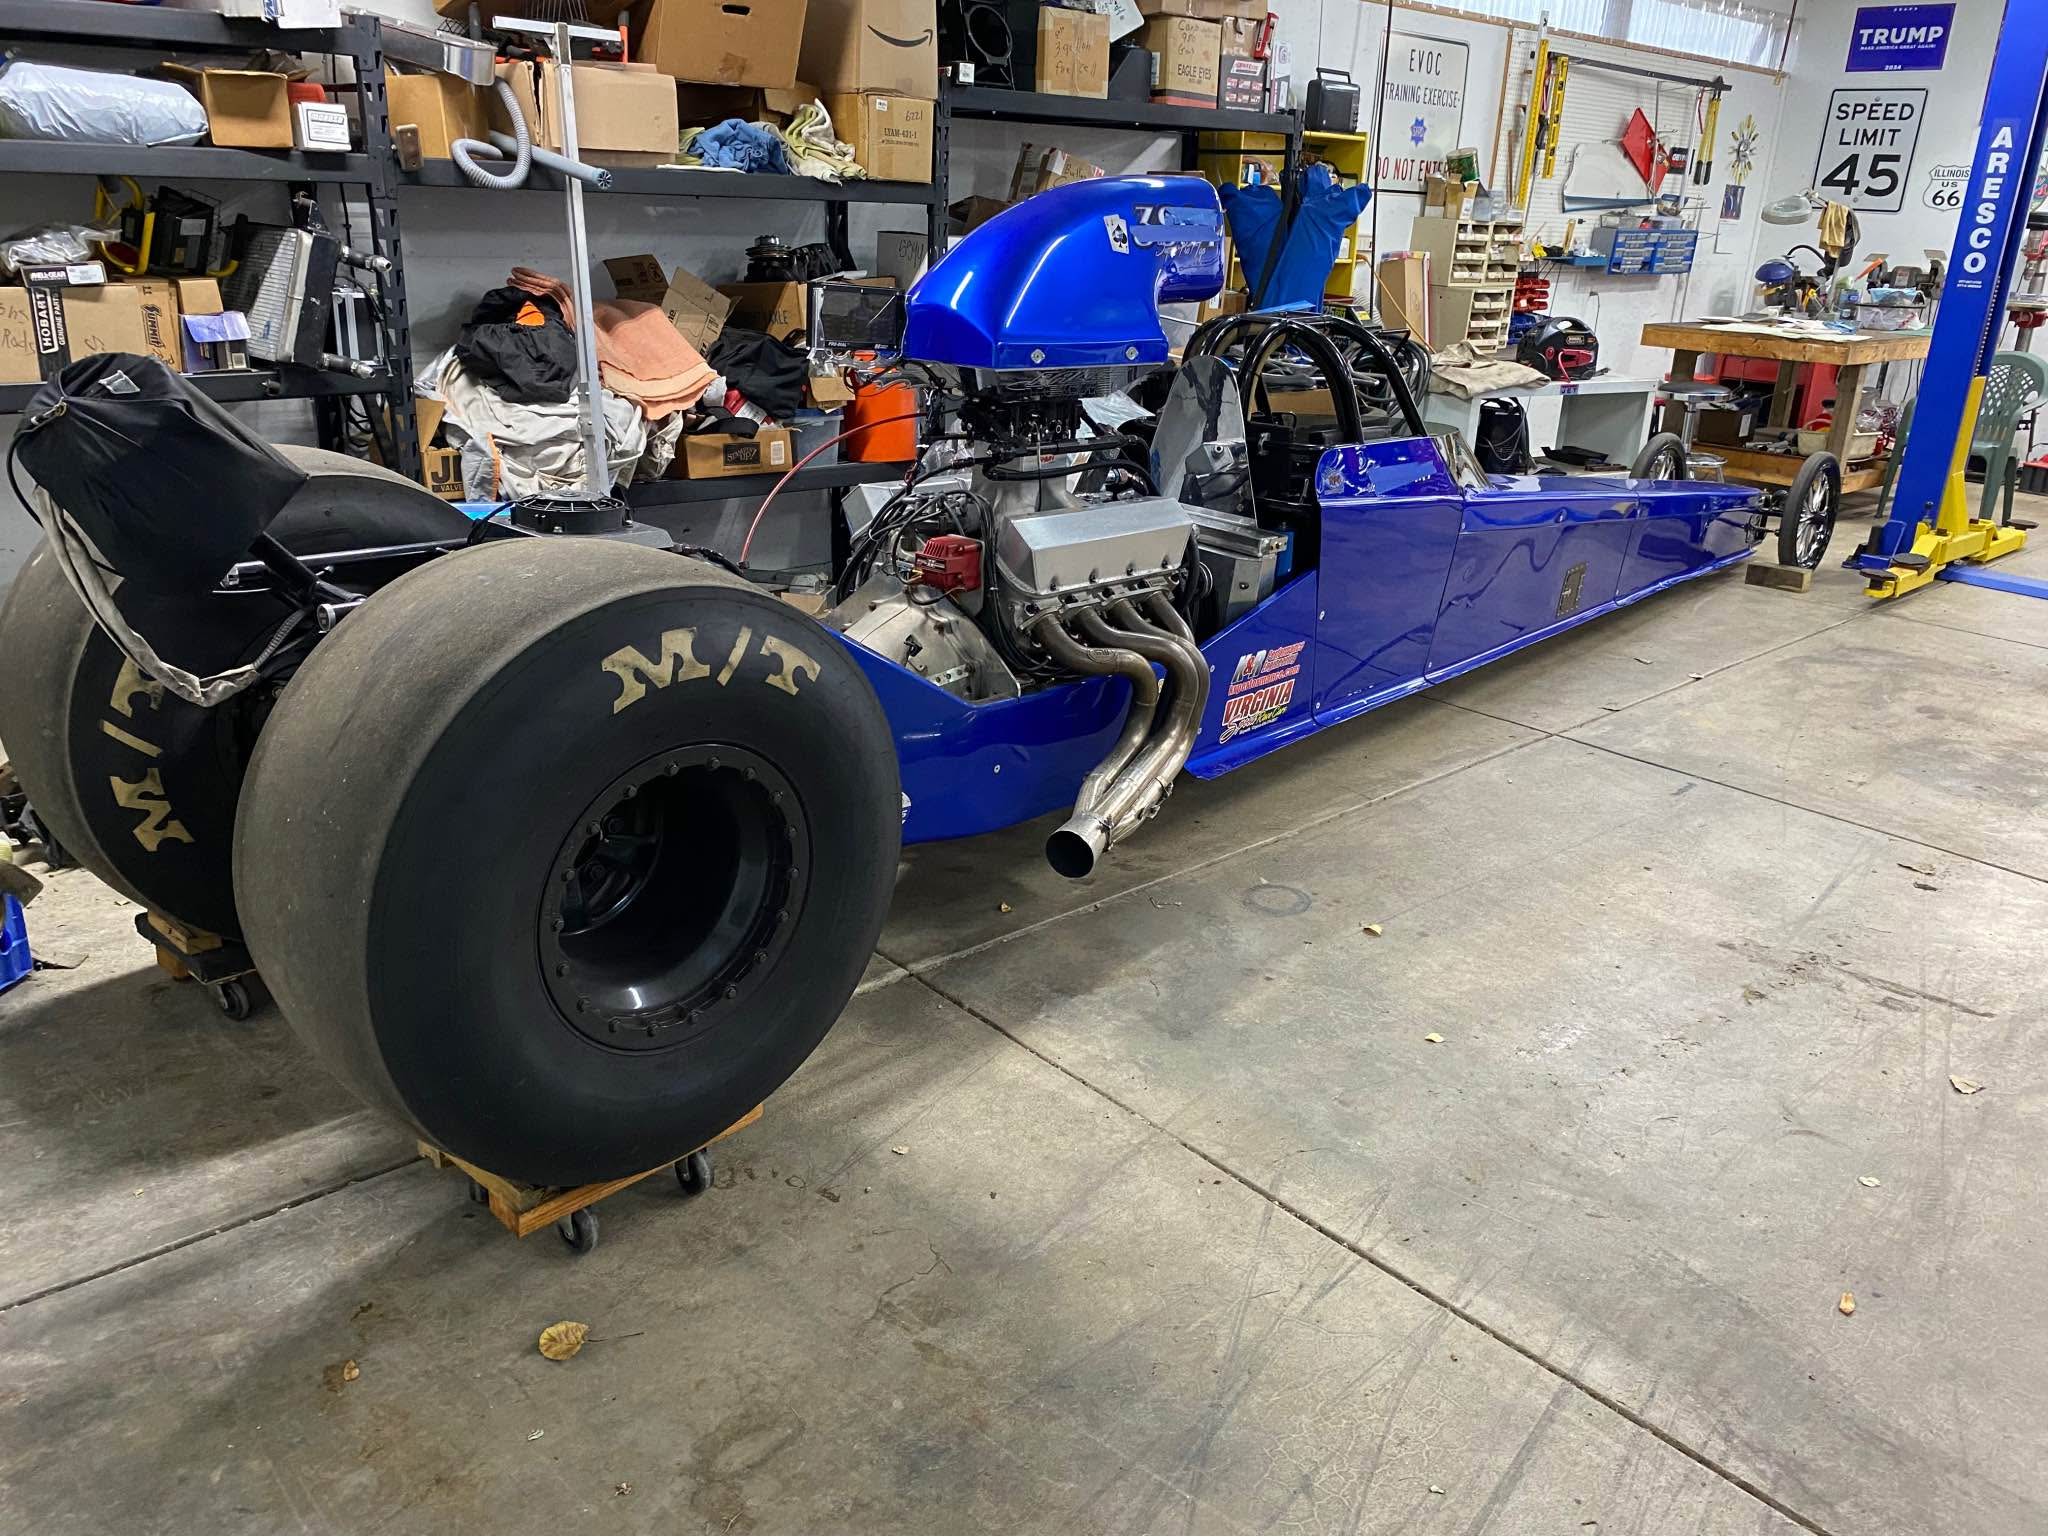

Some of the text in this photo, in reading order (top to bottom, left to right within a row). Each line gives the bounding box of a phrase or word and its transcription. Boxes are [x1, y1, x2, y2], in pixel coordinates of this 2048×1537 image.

[1859, 26, 1944, 45] TRUMP
[1178, 63, 1212, 81] EAGLE EYES
[1409, 49, 1442, 76] EVOC
[1385, 82, 1421, 104] TRAINING
[1836, 103, 1914, 120] SPEED
[1839, 128, 1901, 146] LIMIT
[1393, 157, 1415, 181] NOT
[1821, 153, 1901, 197] 45
[1934, 168, 1970, 178] ILLINOIS
[1932, 190, 1960, 207] 66
[1963, 126, 2013, 274] ARESCO
[36, 292, 52, 347] HOBART
[141, 303, 166, 350] SUMMIT
[601, 626, 821, 714] M/T
[1222, 678, 1295, 726] VIRGINIA
